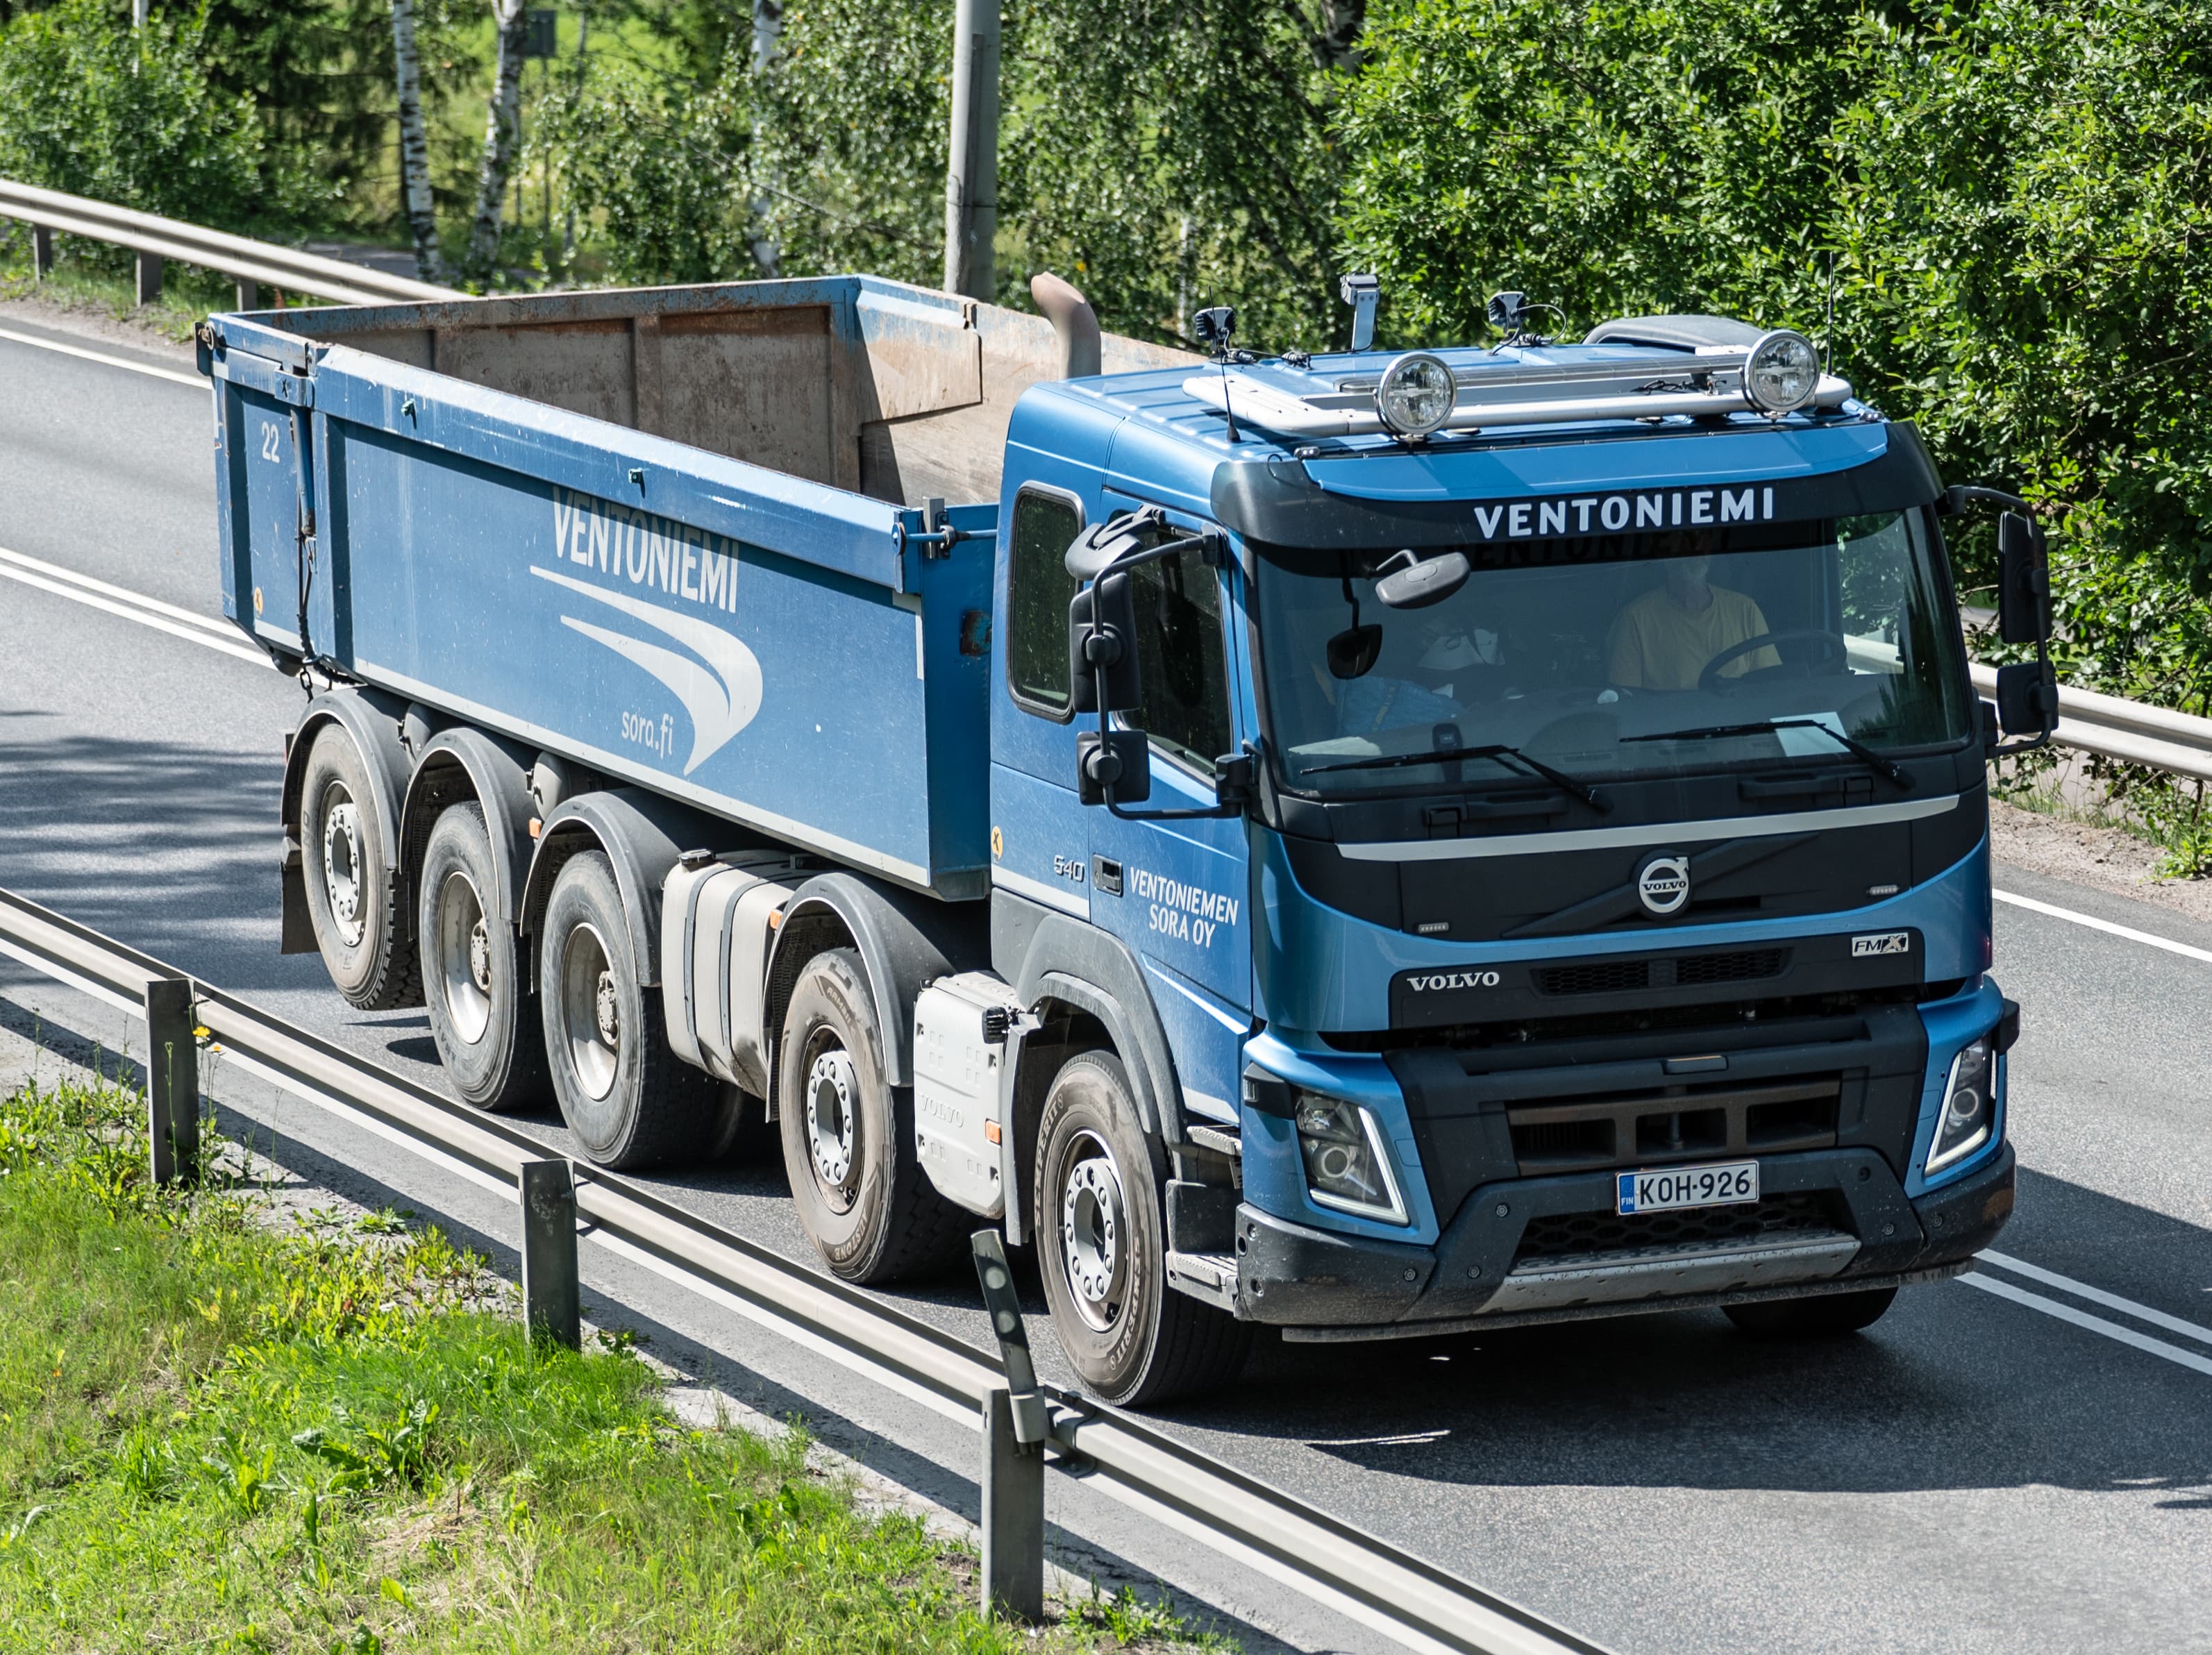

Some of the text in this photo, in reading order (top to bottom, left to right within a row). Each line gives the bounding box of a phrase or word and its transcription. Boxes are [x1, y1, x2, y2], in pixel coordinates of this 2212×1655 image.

[261, 421, 280, 464] 22
[1474, 487, 1774, 539] VENTONIEMI
[553, 487, 739, 614] VENTONIEMI
[621, 710, 674, 760] sora.fi
[1053, 855, 1085, 882] 540
[1642, 880, 1687, 892] VOLVO
[1130, 866, 1239, 927] VENTONIEMEN
[1148, 903, 1216, 948] SORA OY
[1854, 935, 1908, 953] FMX
[1407, 971, 1500, 992] VOLVO
[917, 1093, 964, 1129] VOLVO
[1620, 1197, 1634, 1207] FIN
[1639, 1169, 1751, 1206] KOH-926
